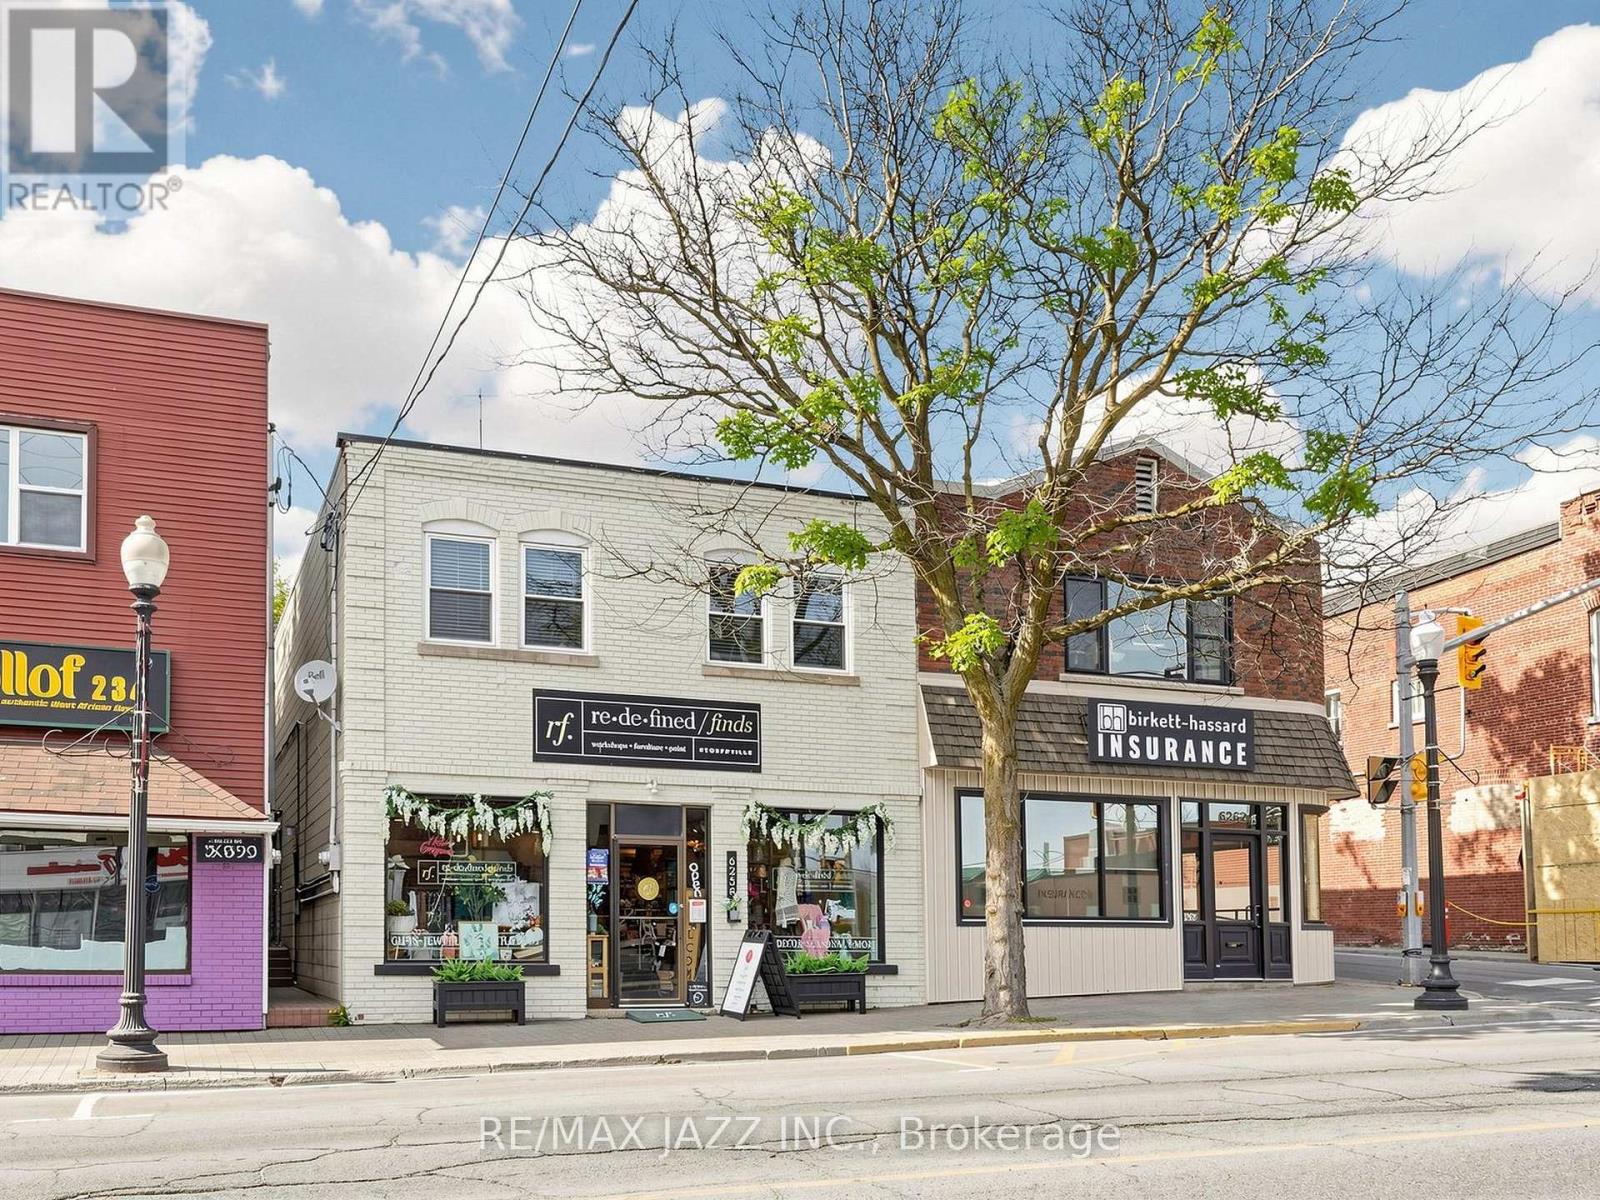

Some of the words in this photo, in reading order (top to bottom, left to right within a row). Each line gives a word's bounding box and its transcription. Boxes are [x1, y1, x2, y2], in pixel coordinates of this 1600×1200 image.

[546, 712, 574, 746] rf.
[706, 712, 753, 735] finds
[1097, 733, 1247, 766] INSURANCE
